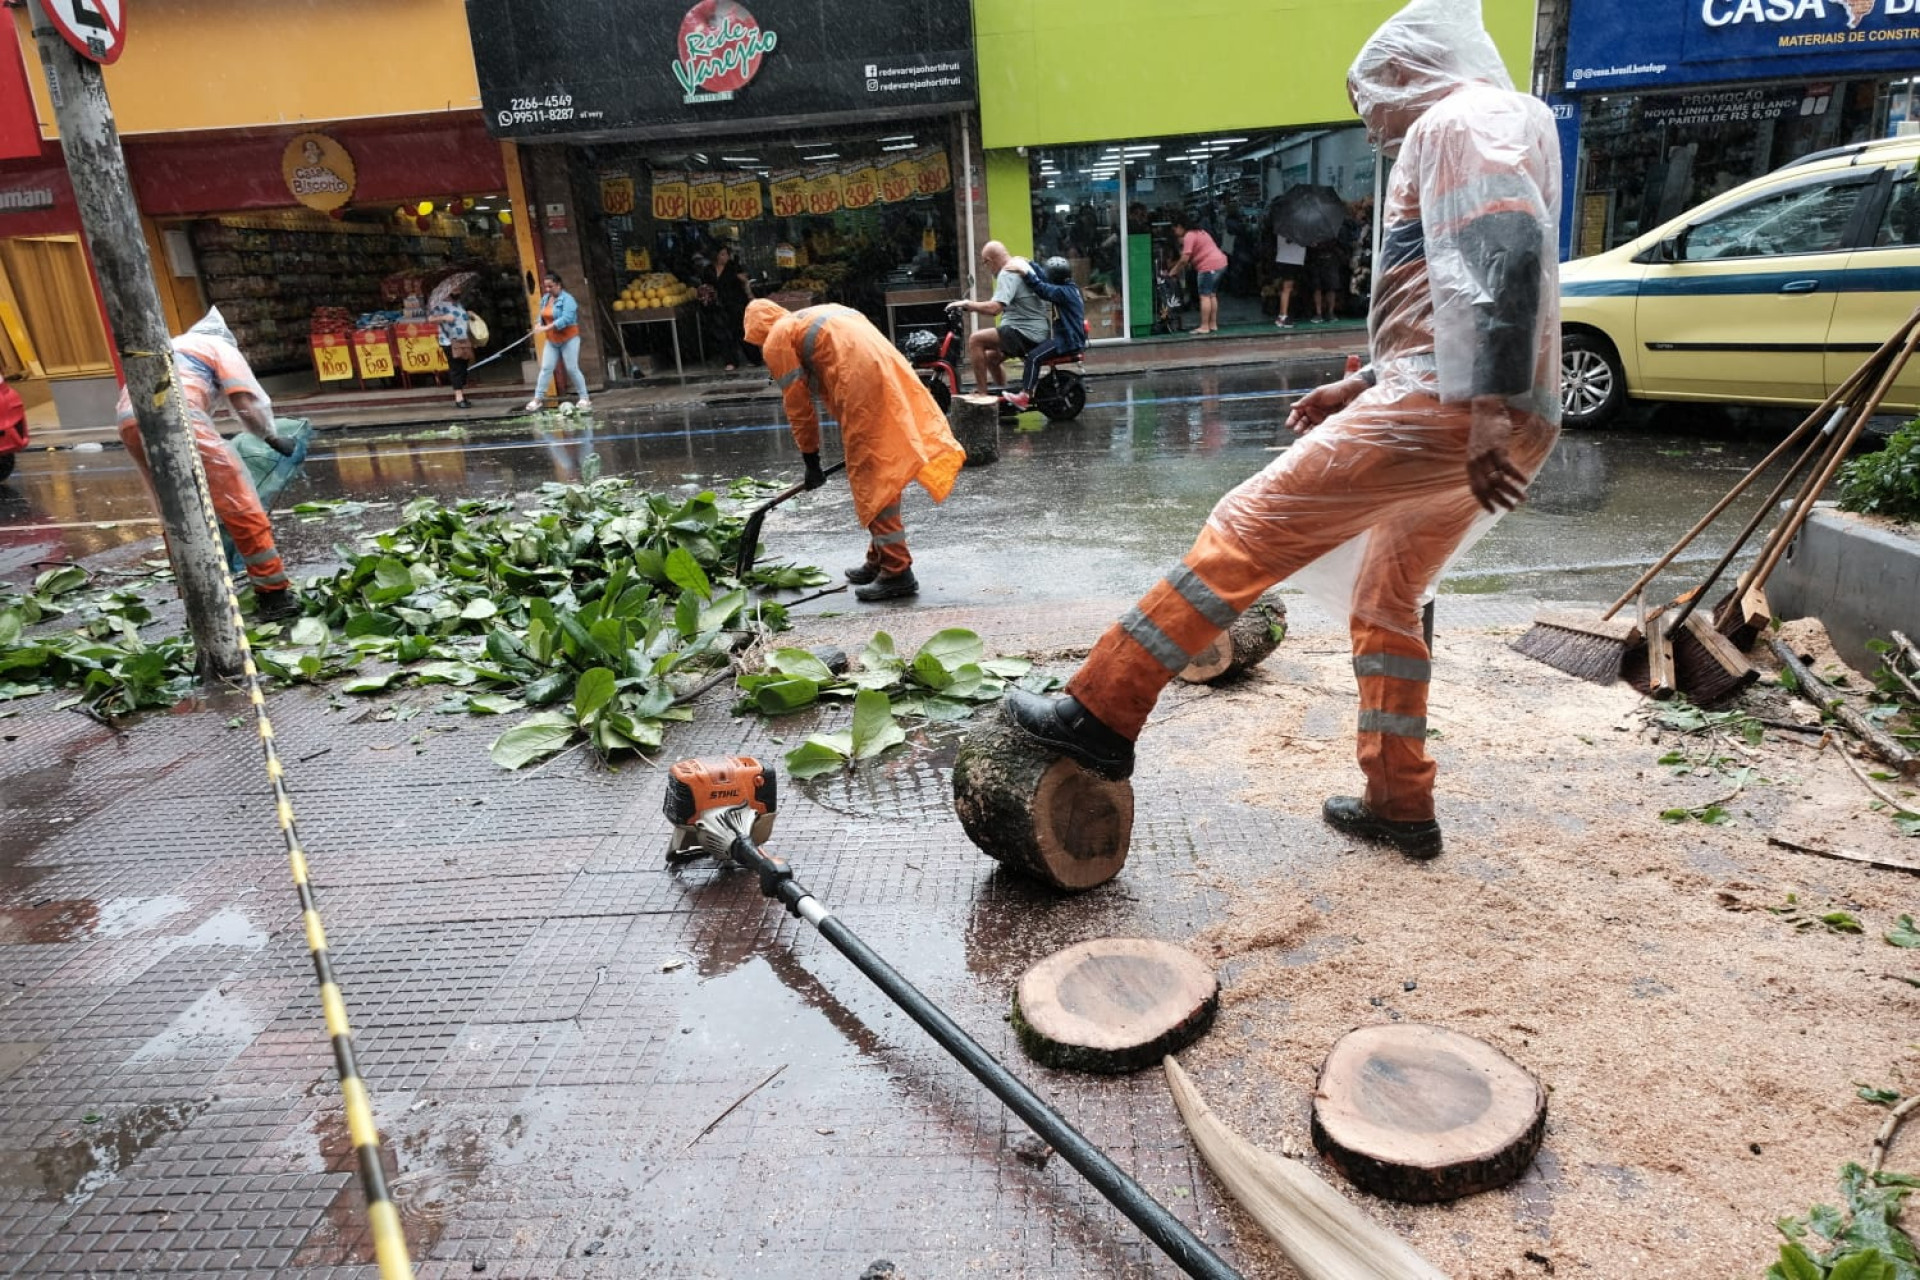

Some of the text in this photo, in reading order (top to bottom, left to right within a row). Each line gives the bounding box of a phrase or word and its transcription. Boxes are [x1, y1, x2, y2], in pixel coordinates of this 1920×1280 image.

[1702, 0, 1826, 27] CASA
[686, 17, 747, 59] Rede
[1778, 32, 1845, 47] MATERIAIS
[1849, 30, 1866, 42] DE
[672, 27, 777, 97] Varejão
[511, 95, 573, 111] 2266-4549
[1682, 88, 1763, 105] PROMOÇÃO
[513, 108, 574, 123] 99511-8287
[1645, 106, 1676, 118] NOVA
[1678, 104, 1715, 116] LINHA
[1718, 102, 1749, 112] FAME
[1669, 114, 1709, 125] PARTIR
[1712, 112, 1727, 122] DE
[1752, 108, 1781, 120] 6,90
[710, 789, 738, 799] STIHL
